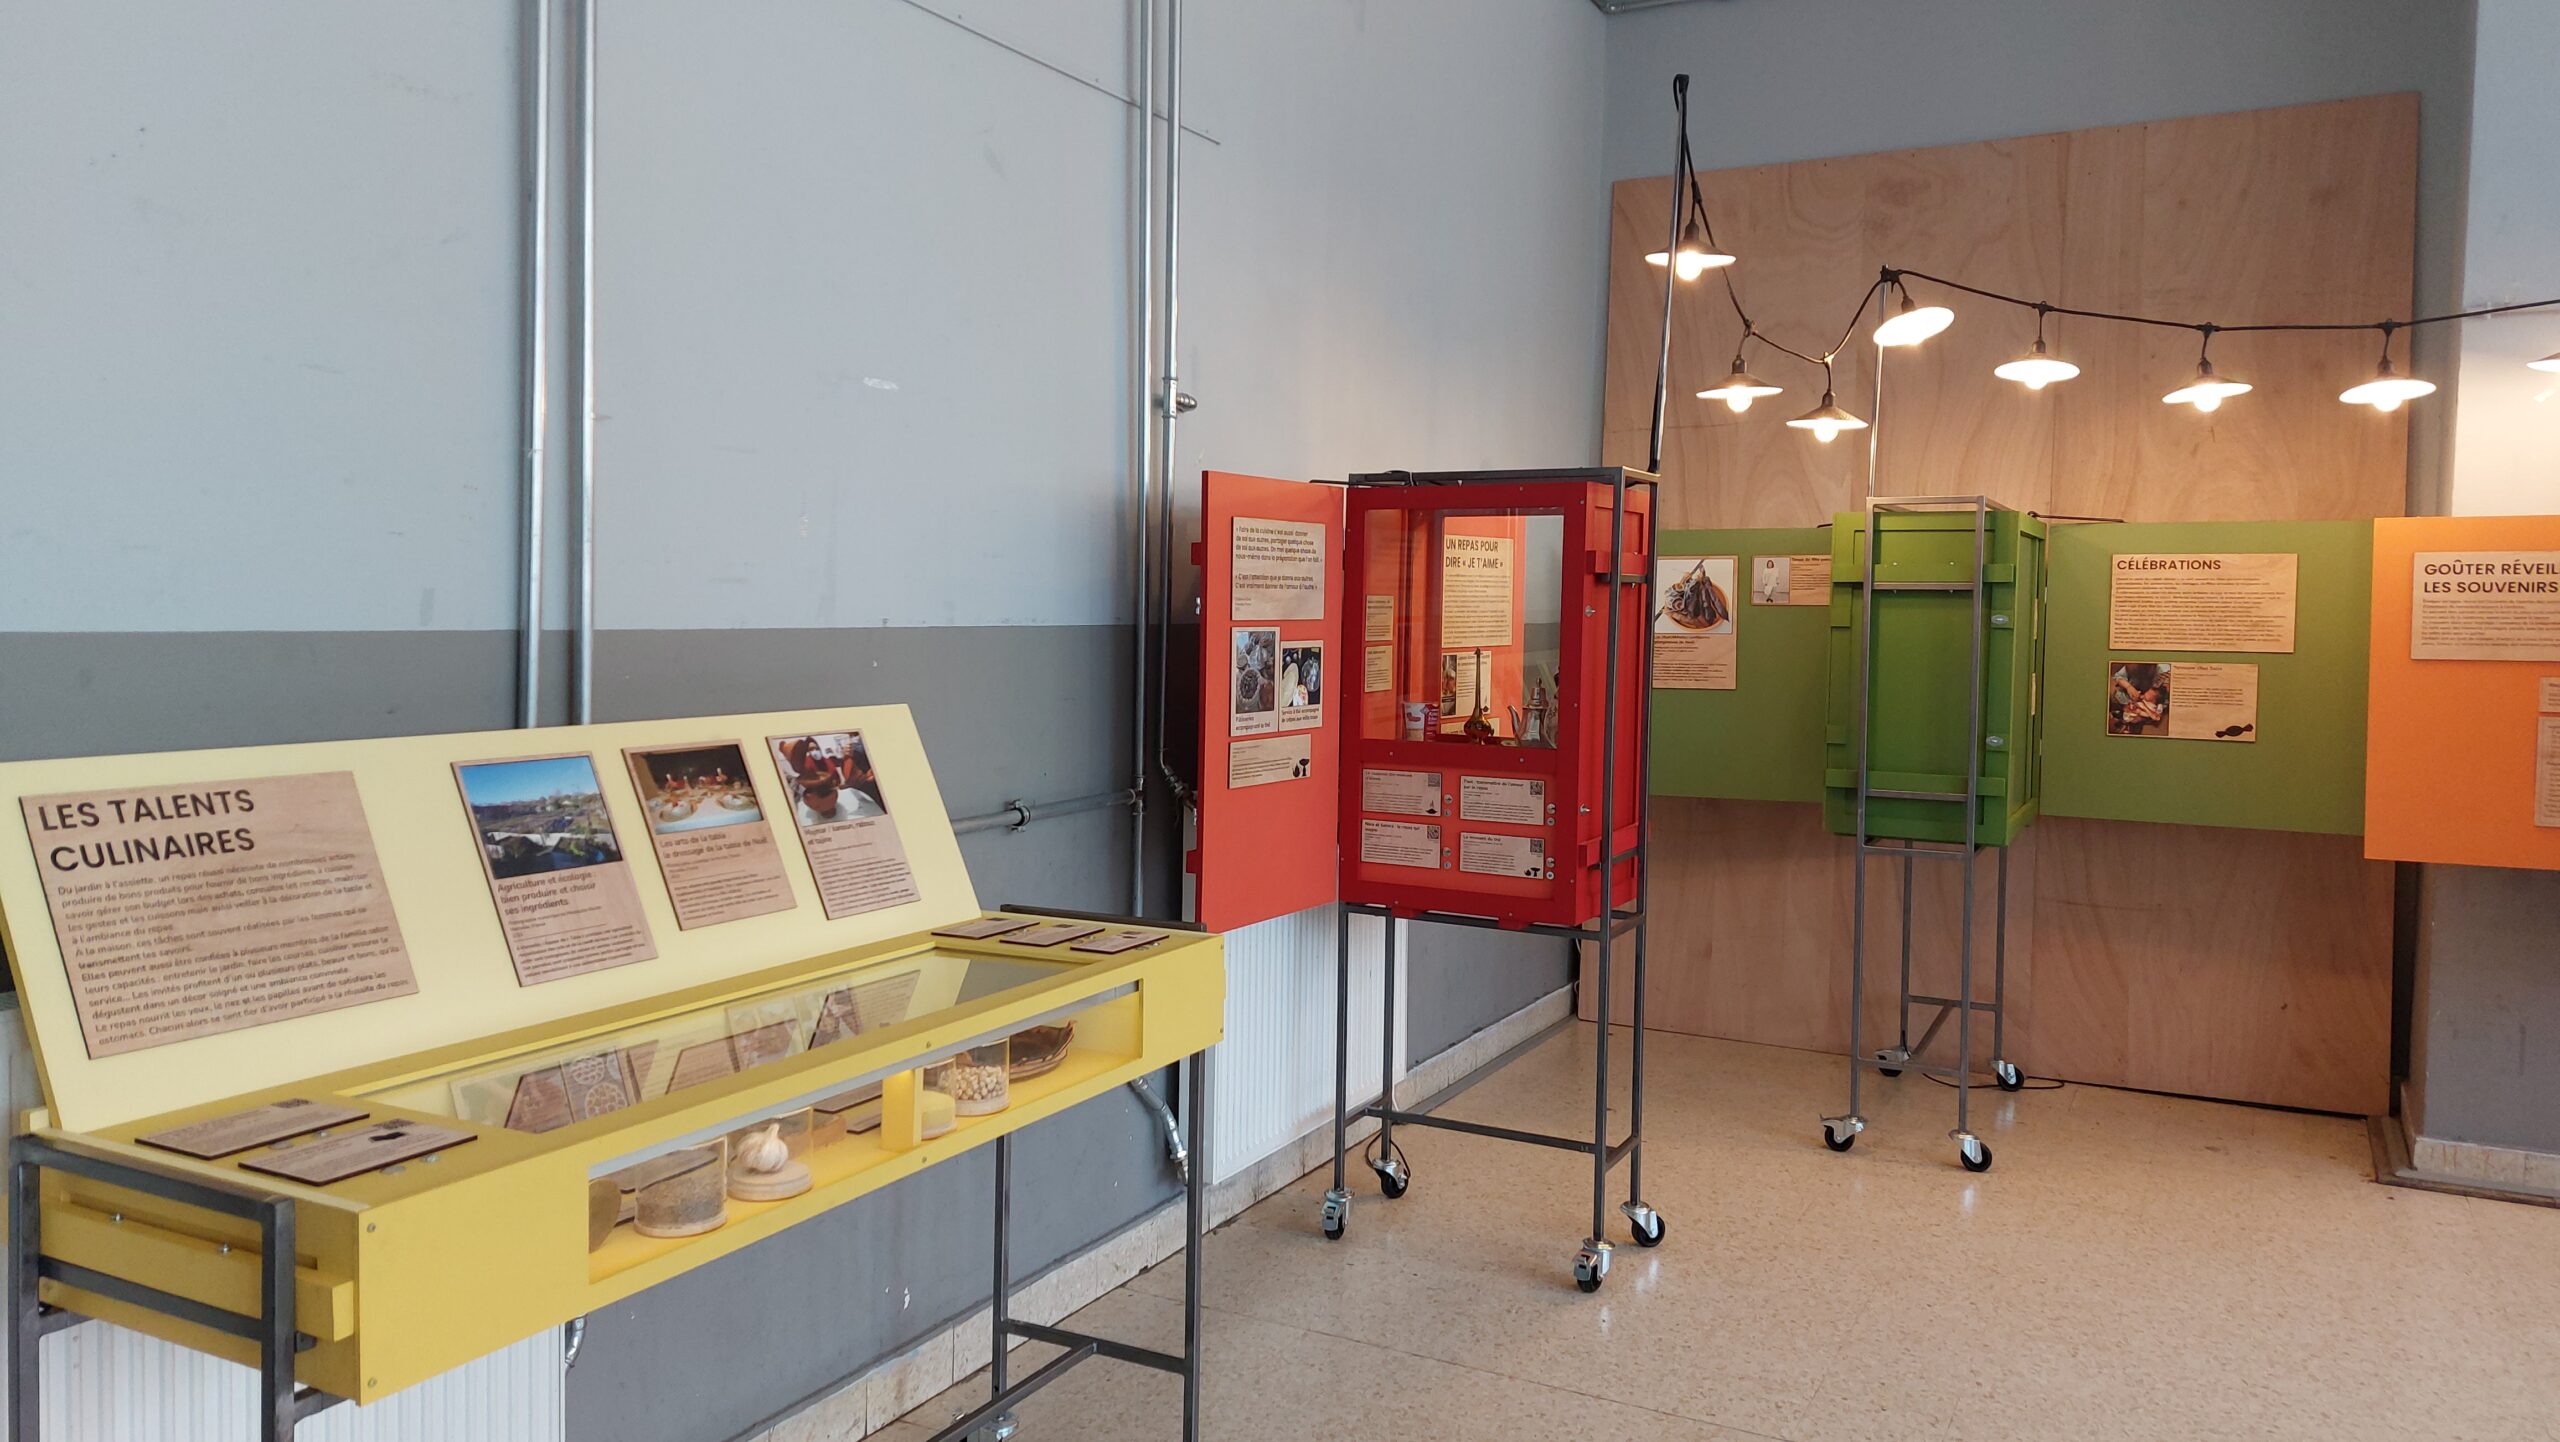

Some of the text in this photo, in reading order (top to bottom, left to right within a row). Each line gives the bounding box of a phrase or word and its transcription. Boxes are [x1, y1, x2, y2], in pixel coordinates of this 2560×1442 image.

[1445, 538, 1498, 552] UN REPAS POUR
[1445, 556, 1461, 567] DIRE
[1467, 557, 1475, 568] JE
[1476, 557, 1499, 569] T'AIME
[2117, 556, 2221, 571] CÉLÉBRATIONS
[2424, 559, 2495, 576] GOÛTER
[2423, 581, 2559, 594] LES SOUVENIRS
[38, 789, 255, 831] LES TALENTS
[50, 827, 255, 871] CULINAIRES
[57, 886, 73, 895] Du
[73, 882, 102, 896] jardin
[103, 881, 111, 889] à
[496, 879, 546, 893] Agriculture
[557, 871, 592, 882] écologie
[60, 895, 102, 910] produire
[103, 893, 117, 901] de
[117, 891, 142, 900] bons
[143, 884, 182, 899] produits
[499, 895, 520, 903] bien
[520, 889, 558, 902] produire
[569, 882, 596, 892] choisir
[64, 908, 94, 919] savoir
[96, 905, 122, 917] gérer
[123, 903, 141, 911] son
[141, 897, 176, 909] budget
[519, 899, 569, 913] ingrédients
[66, 923, 83, 932] les
[84, 919, 117, 932] gestes
[118, 916, 129, 925] et
[70, 935, 78, 944] à
[132, 926, 146, 935] du
[84, 947, 96, 955] la
[80, 971, 106, 982] Elles
[107, 964, 147, 980] peuvent
[83, 984, 110, 995] leurs
[90, 1004, 141, 1020] dégustent
[94, 1023, 108, 1032] Le
[109, 1018, 137, 1030] repas
